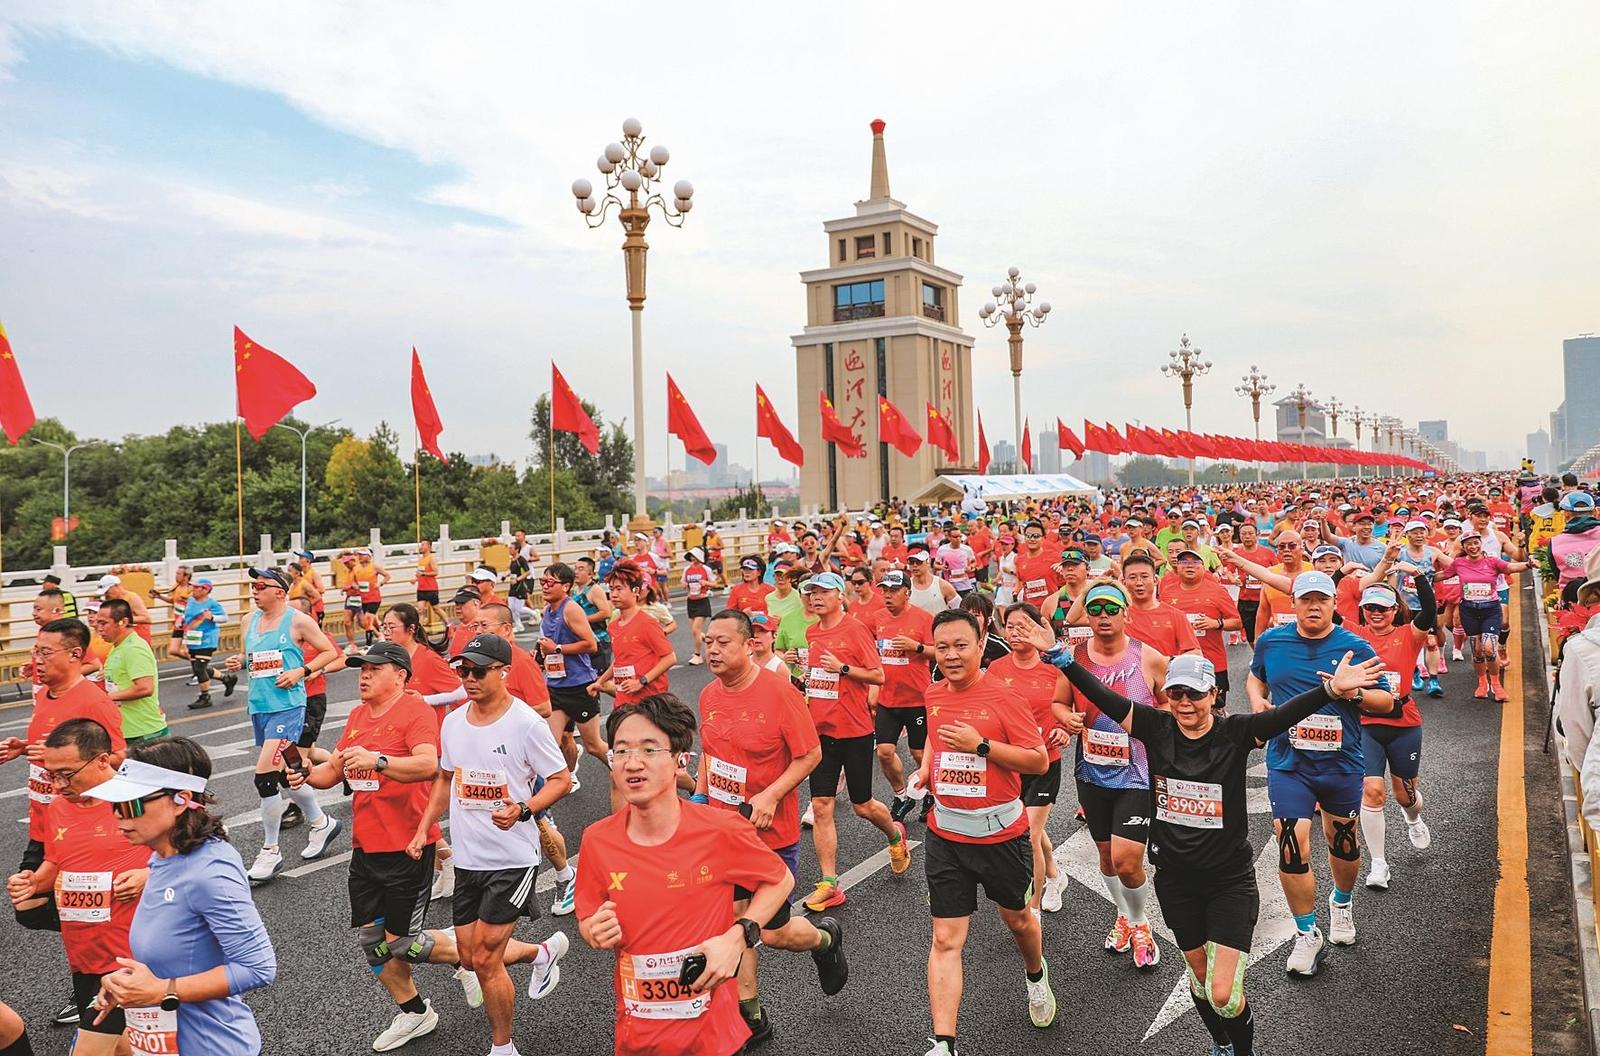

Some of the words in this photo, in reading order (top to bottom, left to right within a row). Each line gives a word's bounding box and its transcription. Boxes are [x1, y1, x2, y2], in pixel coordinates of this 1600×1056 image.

[1301, 728, 1338, 742] 30488
[1090, 743, 1124, 758] 33364
[710, 774, 741, 794] 33363
[941, 770, 981, 785] 29805
[465, 785, 503, 799] 34408
[1158, 794, 1168, 806] G
[1170, 797, 1217, 816] 39094
[63, 892, 104, 908] 32930
